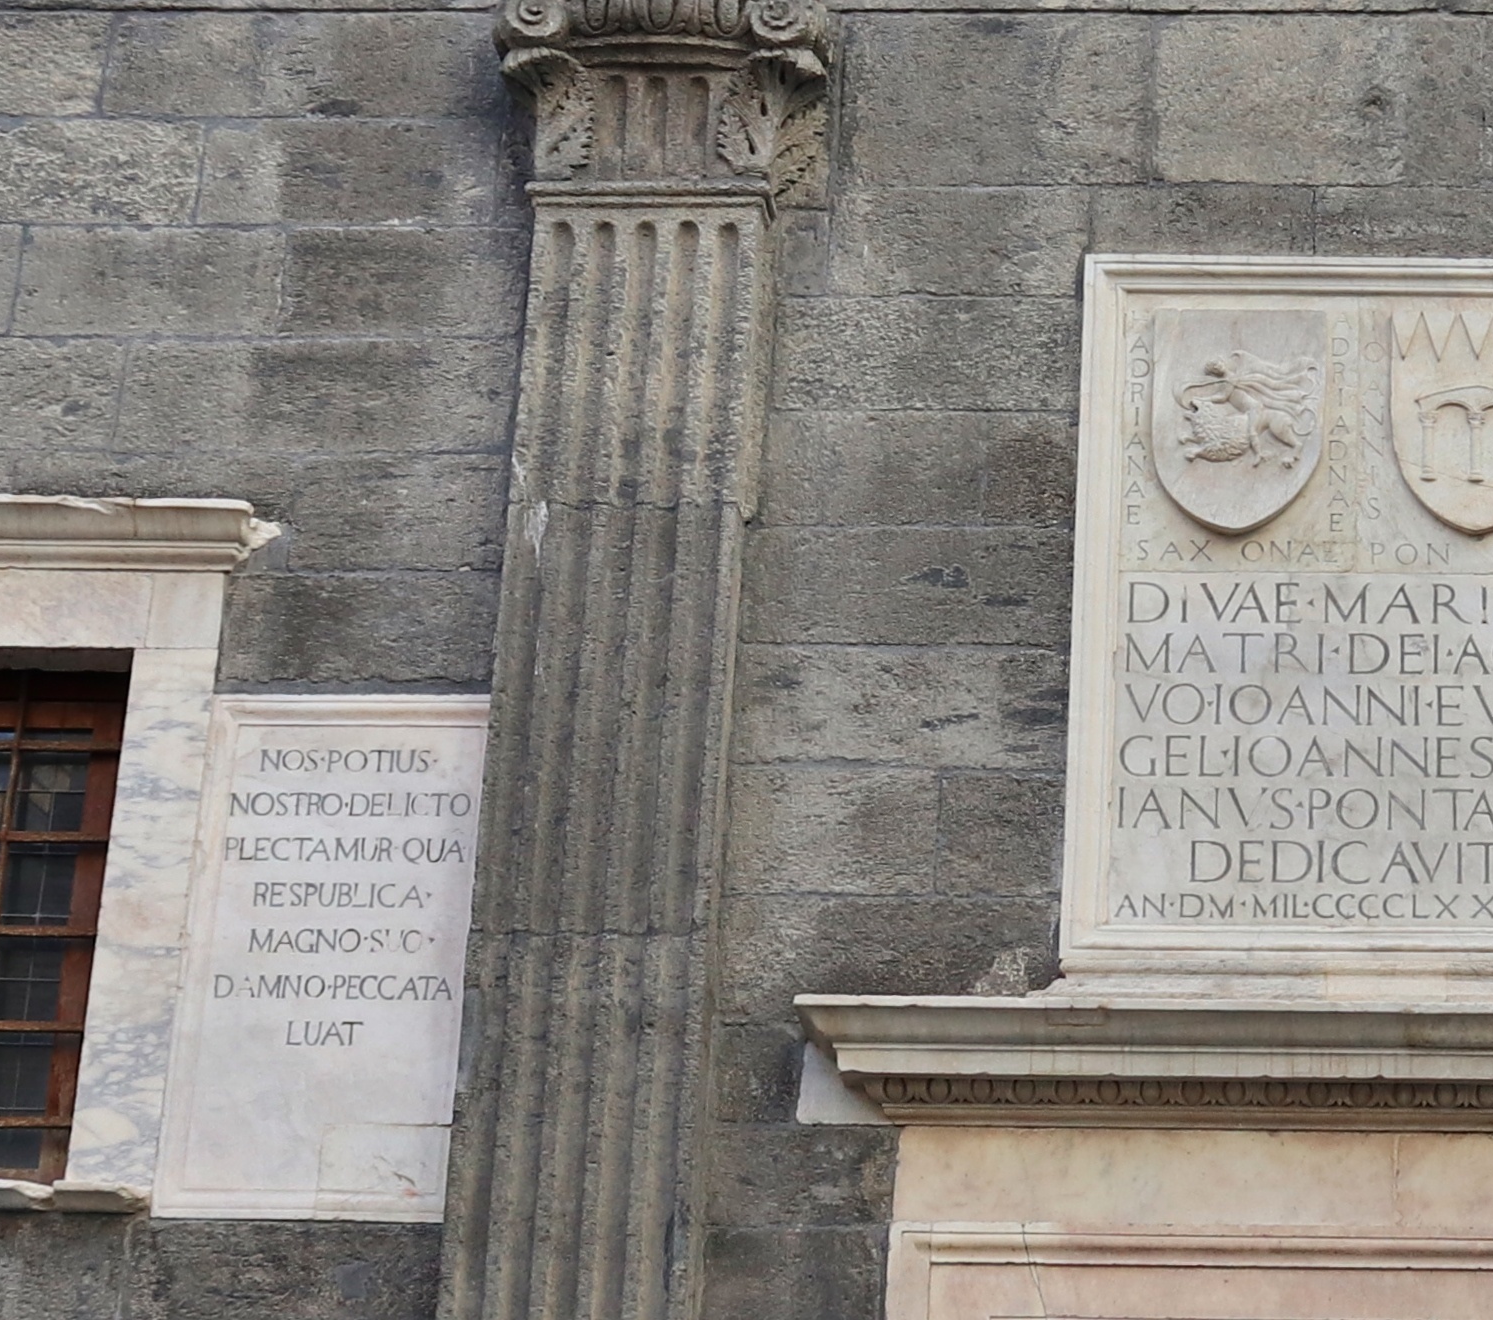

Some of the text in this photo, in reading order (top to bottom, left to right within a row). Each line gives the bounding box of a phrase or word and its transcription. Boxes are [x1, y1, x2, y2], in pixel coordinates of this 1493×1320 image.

[1127, 581, 1302, 623] DIVAE
[1124, 632, 1323, 674] MATRI
[1348, 632, 1440, 675] DEI
[1124, 683, 1206, 726] VO
[1213, 683, 1421, 727] IOANNI
[259, 749, 432, 774] NOS POTIUS
[1119, 735, 1224, 777] GEL
[230, 792, 472, 818] NOSTRO DELICTO
[1117, 786, 1294, 830] IANVS
[224, 837, 466, 864] PLECTAMUR QUA
[252, 881, 425, 909] RESPUBLICA
[248, 927, 362, 954] MAGNO
[331, 974, 453, 1001] PECCATA
[285, 1020, 364, 1047] LUAT
